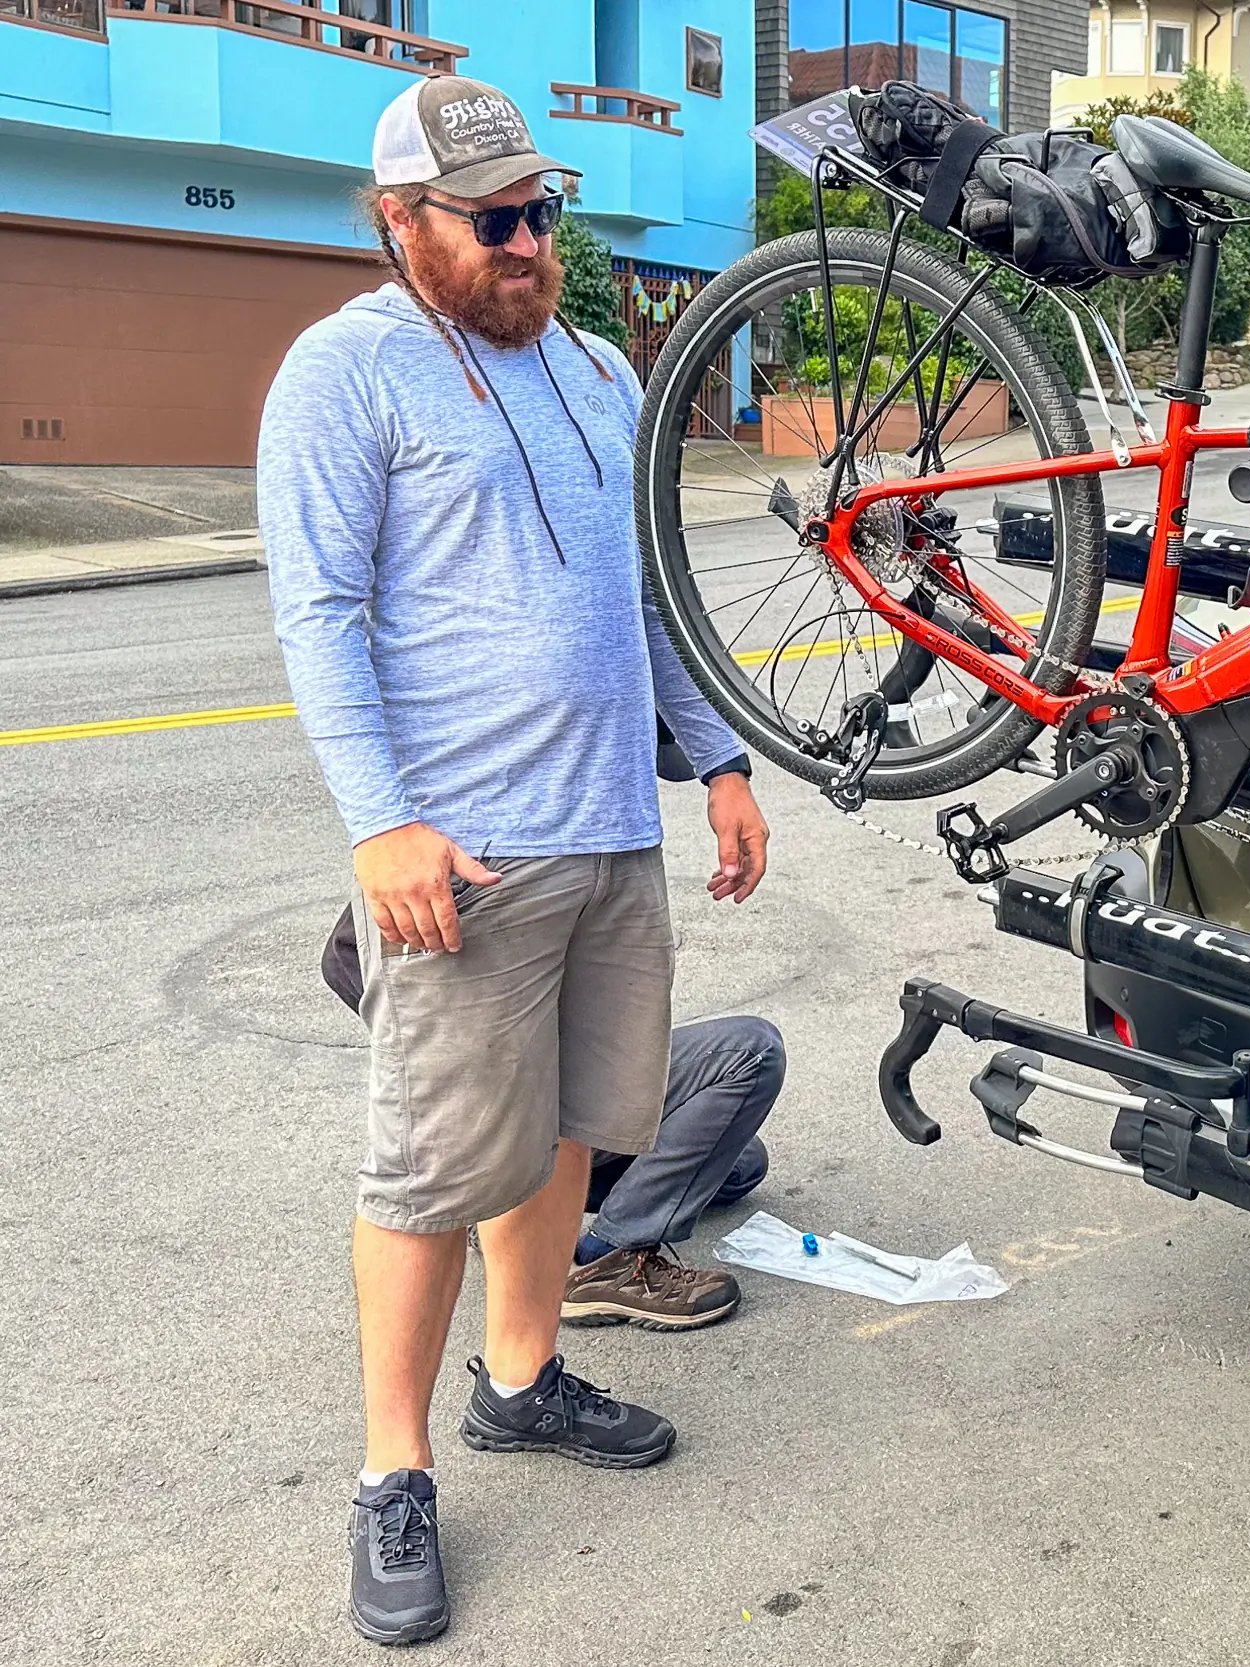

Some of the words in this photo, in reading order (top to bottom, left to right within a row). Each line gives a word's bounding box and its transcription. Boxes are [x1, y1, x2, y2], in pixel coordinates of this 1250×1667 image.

[451, 122, 494, 139] Country
[185, 186, 235, 210] 855
[983, 666, 1025, 697] CORE
